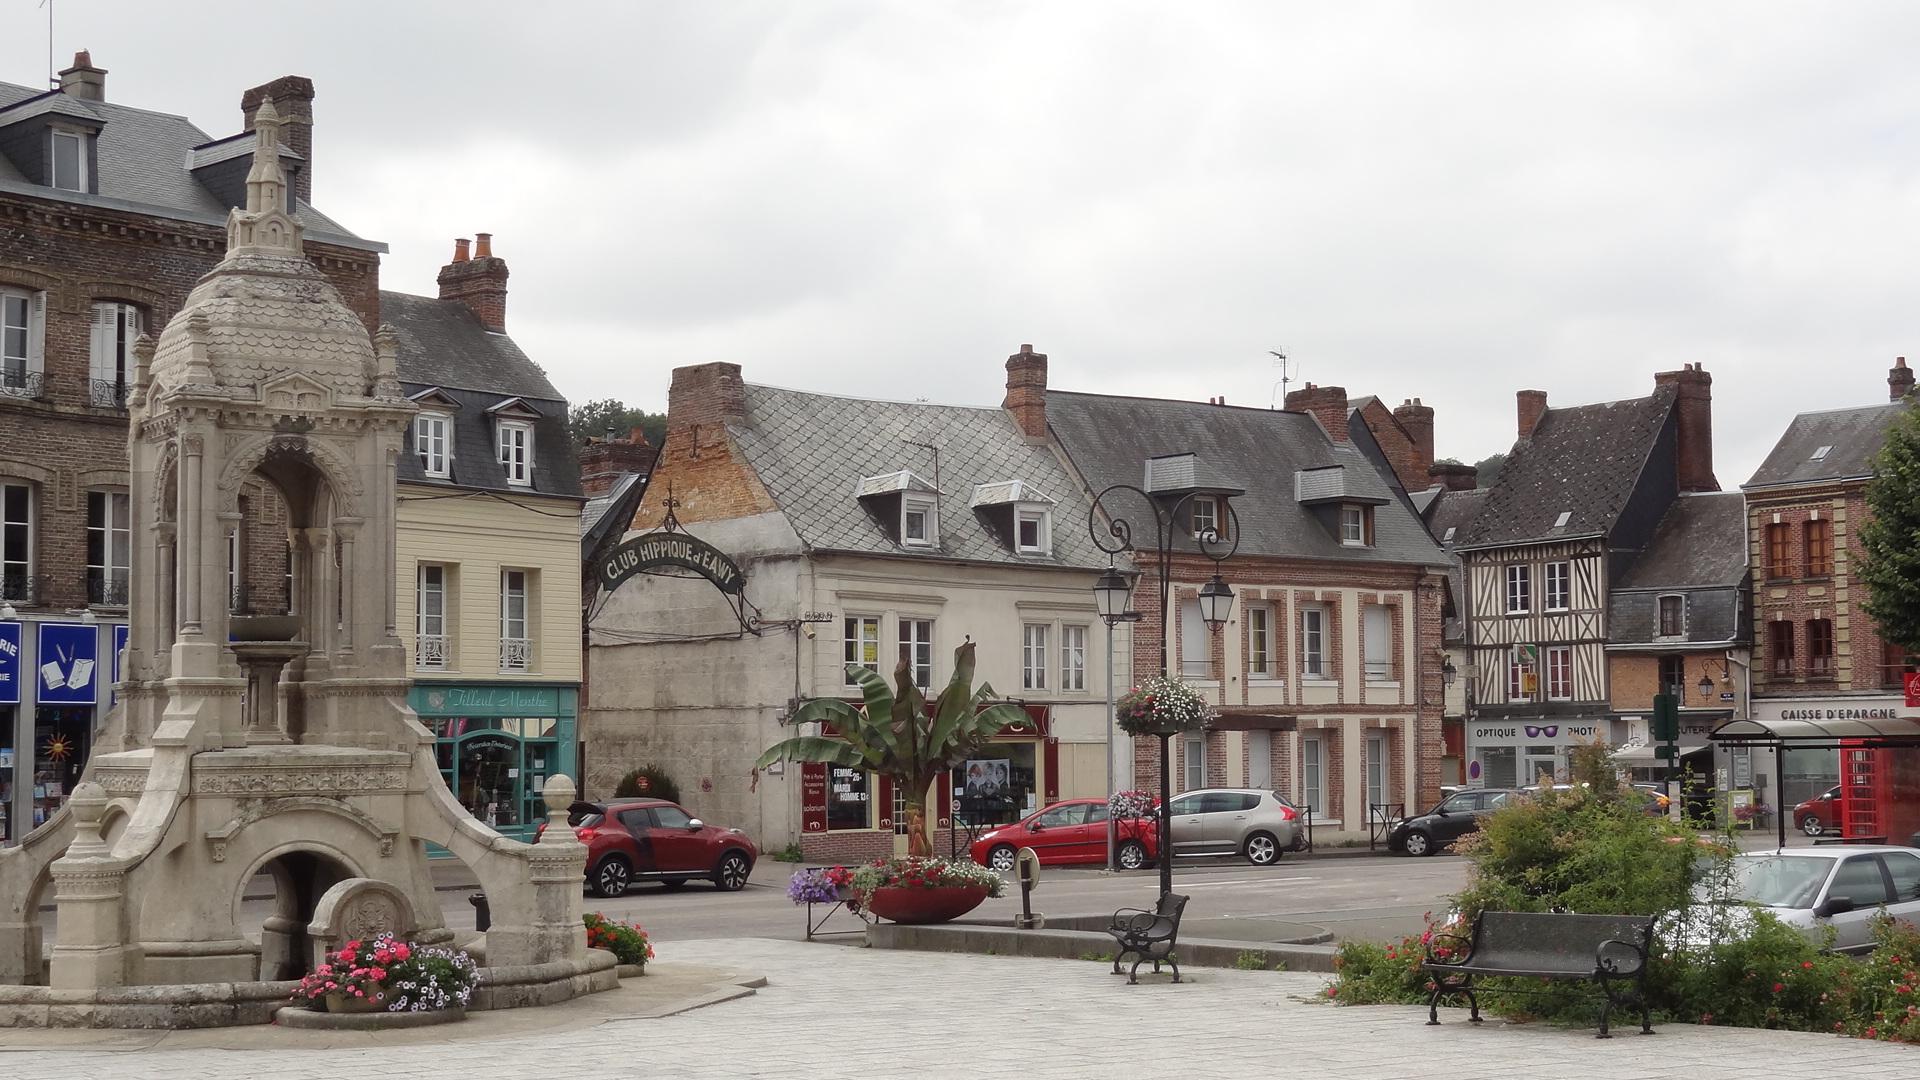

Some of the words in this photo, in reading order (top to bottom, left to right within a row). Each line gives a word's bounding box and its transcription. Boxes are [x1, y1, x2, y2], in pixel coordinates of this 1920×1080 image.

[606, 550, 639, 579] CLUB
[640, 540, 693, 562] HIPPIQUE
[1781, 709, 1821, 720] CAISSE
[1827, 708, 1897, 720] D'EPARGNE
[1476, 728, 1516, 738] OPTIQUE
[1677, 725, 1713, 735] UTERIE
[833, 768, 853, 778] FEMME
[840, 792, 860, 801] HOMME
